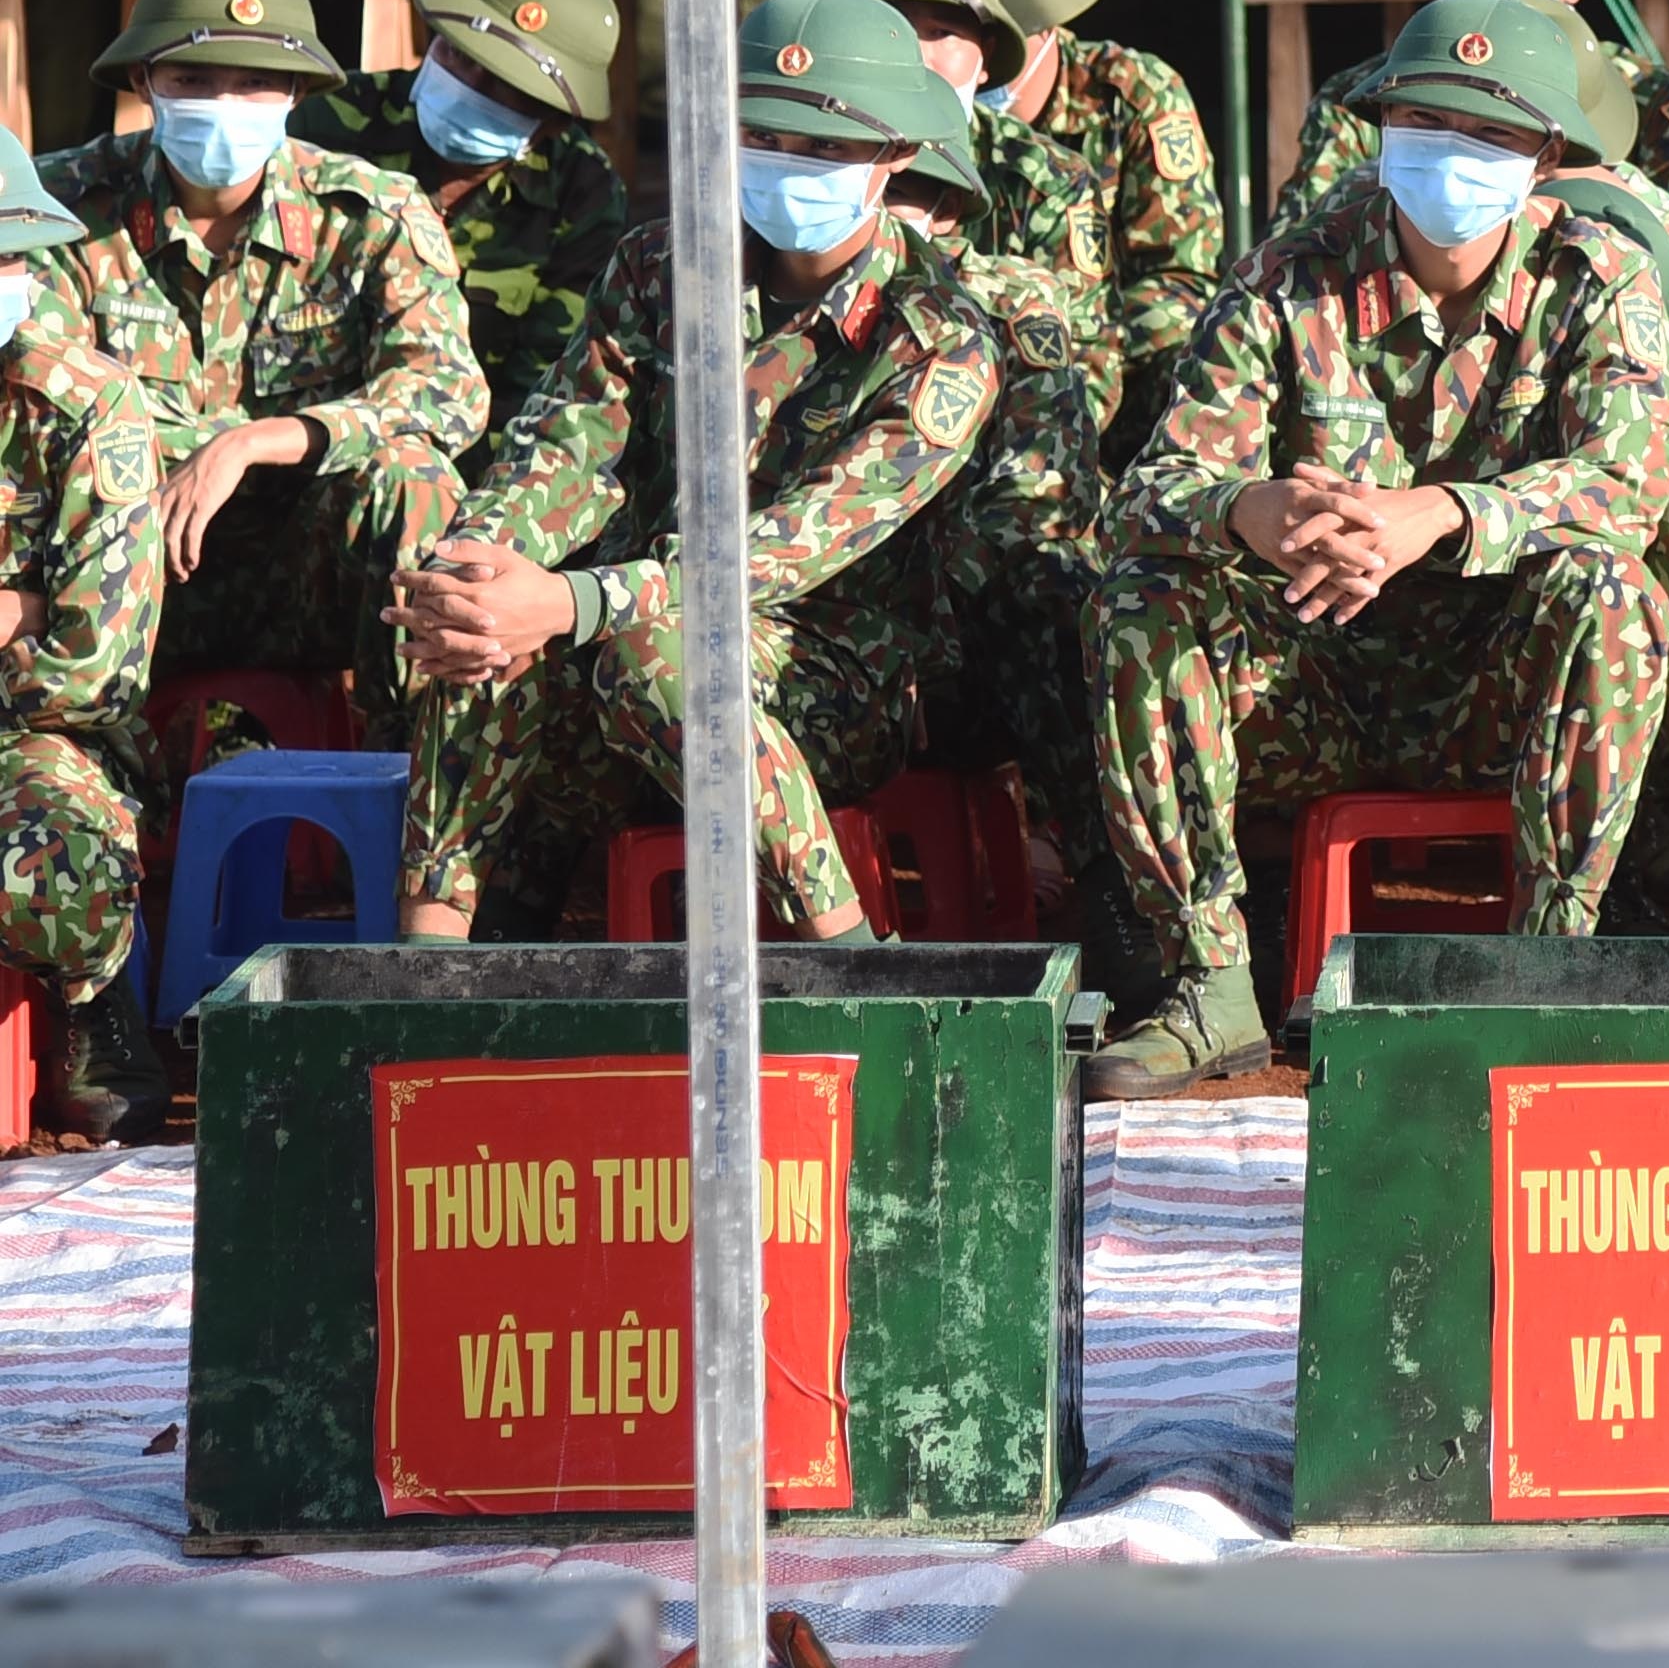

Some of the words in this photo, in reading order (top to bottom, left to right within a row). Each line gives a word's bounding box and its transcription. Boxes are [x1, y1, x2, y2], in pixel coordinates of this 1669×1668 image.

[406, 1144, 577, 1251] THÙNG
[593, 1157, 690, 1244] THU
[459, 1313, 552, 1438] VẬT
[570, 1311, 679, 1434] LIỆU
[1571, 1317, 1661, 1440] VẬT
